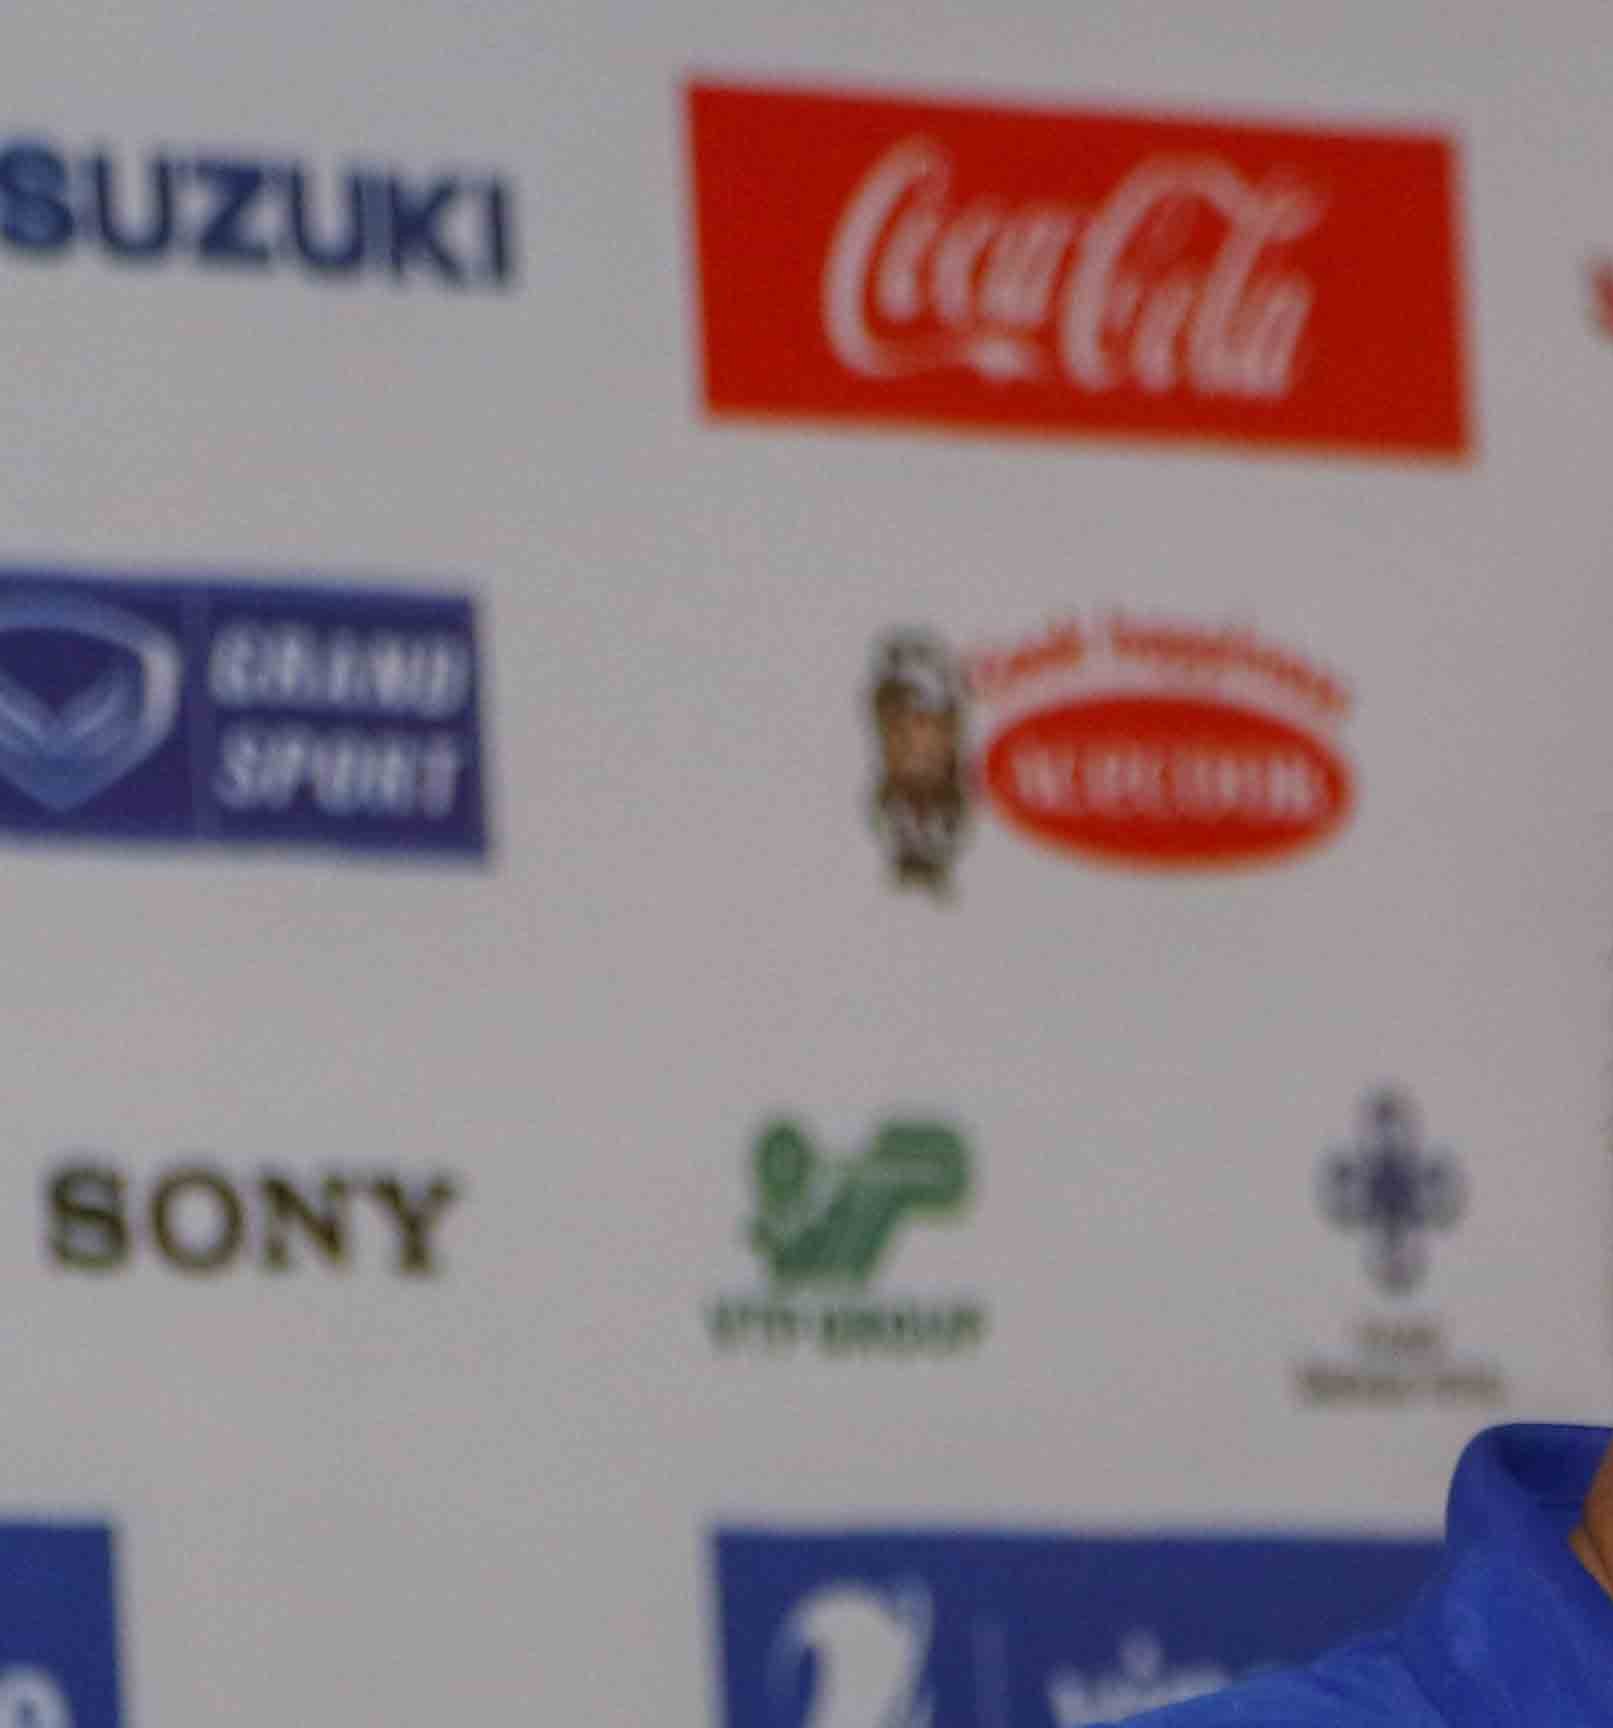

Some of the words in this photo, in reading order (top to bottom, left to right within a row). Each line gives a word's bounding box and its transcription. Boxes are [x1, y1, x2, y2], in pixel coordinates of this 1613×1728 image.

[0, 132, 516, 288] SUZUKI
[210, 622, 472, 716] GRAND
[214, 726, 462, 818] SPORT
[42, 1160, 458, 1280] SONY
